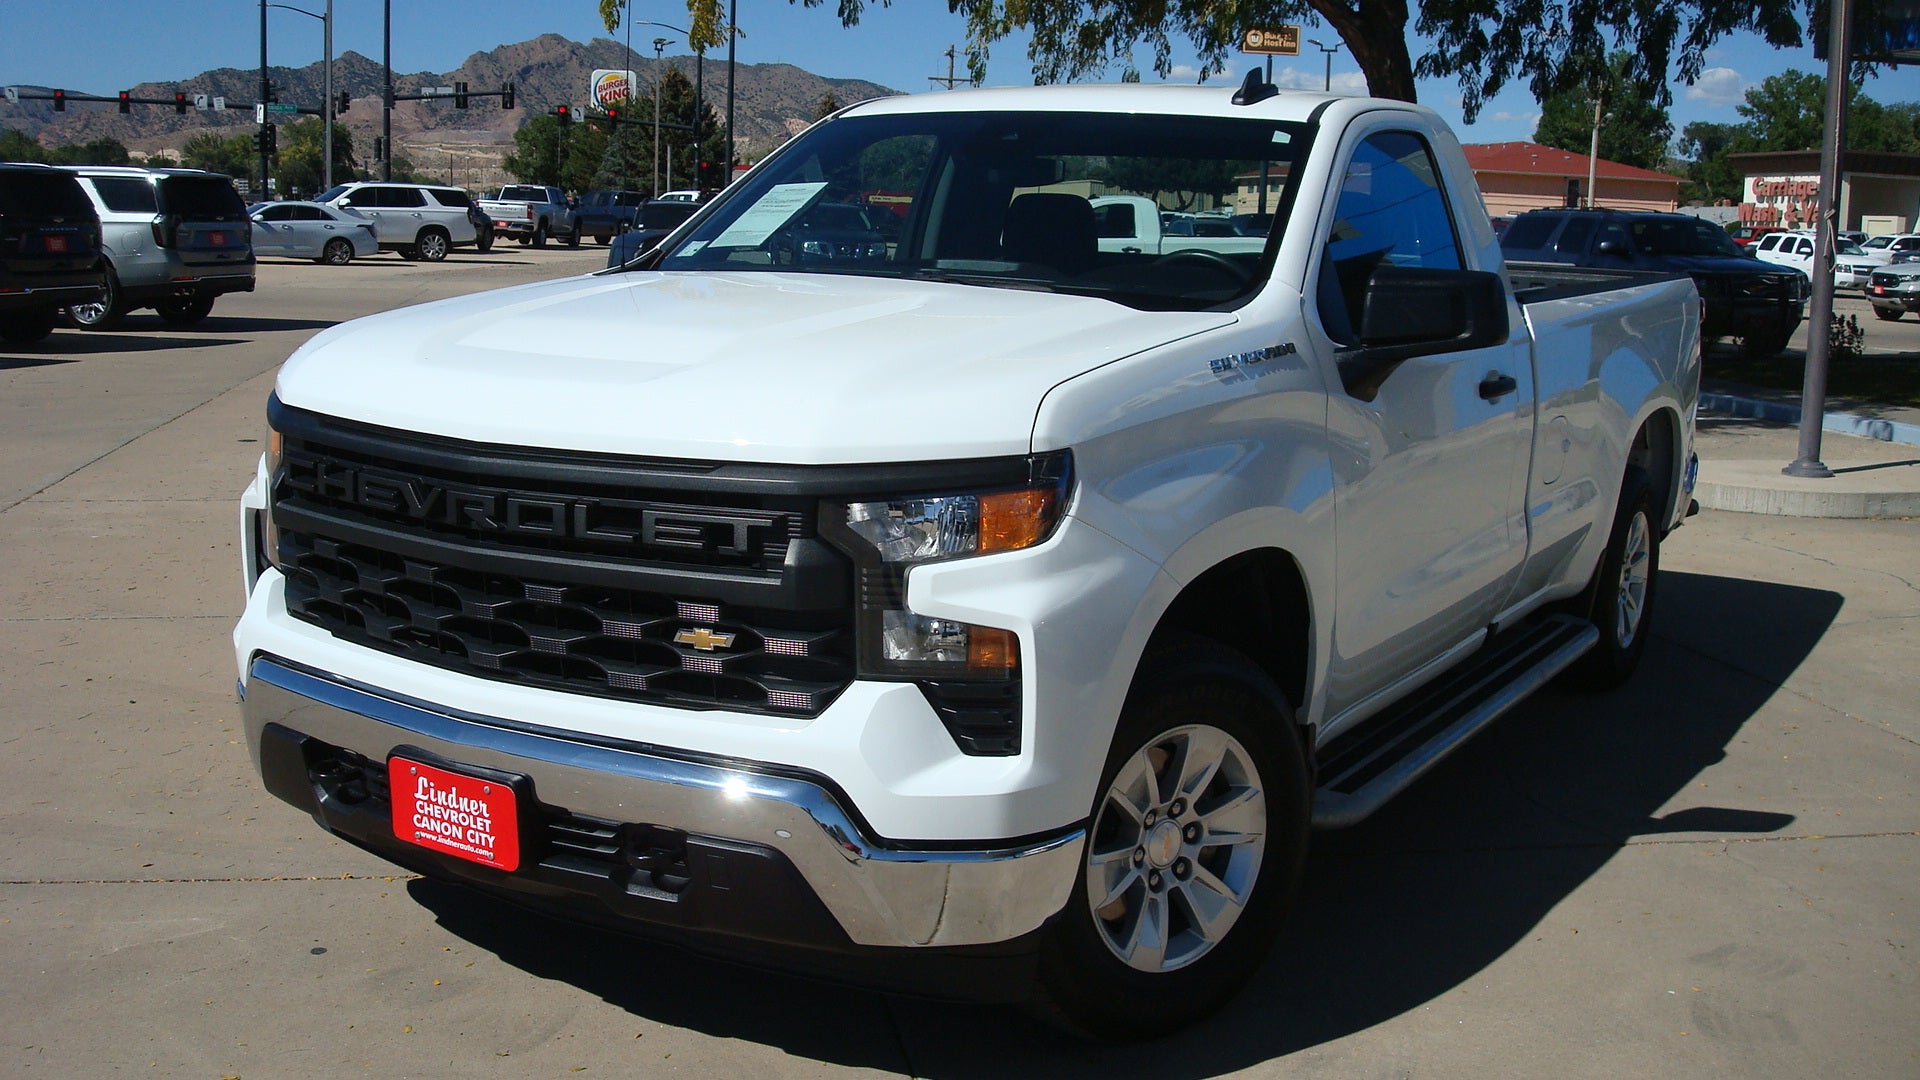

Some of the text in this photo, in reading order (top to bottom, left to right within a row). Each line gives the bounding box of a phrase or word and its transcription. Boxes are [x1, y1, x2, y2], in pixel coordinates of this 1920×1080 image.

[598, 79, 629, 93] BURGER
[600, 87, 631, 102] KING
[1752, 177, 1818, 200] Carriage
[1738, 202, 1776, 222] Wash
[1784, 202, 1797, 221] &
[1208, 343, 1297, 373] SILVERADO
[284, 456, 783, 555] CHEVROLET
[414, 776, 490, 818] Lindner
[415, 800, 491, 832] CHEVROLET
[413, 814, 495, 849] CANON CITY
[420, 831, 489, 857] www.lindnerauto.com
